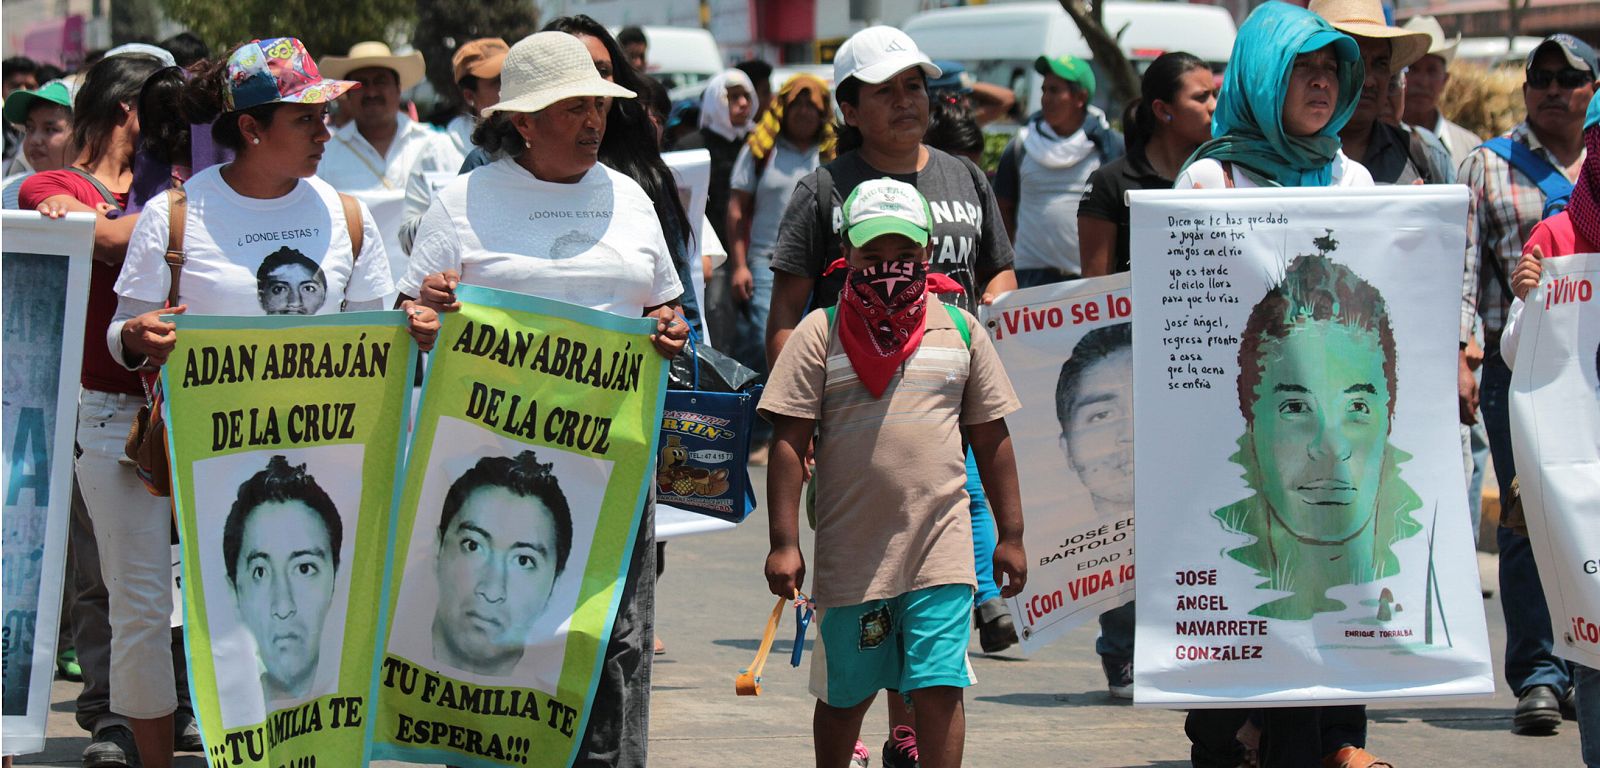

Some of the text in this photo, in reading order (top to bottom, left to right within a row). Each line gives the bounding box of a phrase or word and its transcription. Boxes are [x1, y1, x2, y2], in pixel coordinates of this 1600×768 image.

[1193, 219, 1205, 231] que
[1226, 212, 1243, 225] has
[1248, 212, 1289, 231] quedado
[245, 232, 280, 244] DONDE
[281, 228, 312, 240] ESTAS
[1170, 228, 1245, 246] a jugar con tus
[1167, 246, 1200, 260] amigos
[1217, 246, 1227, 256] el
[1169, 264, 1229, 280] ya es tarde
[1169, 280, 1179, 290] el
[1209, 278, 1232, 289] llora
[1162, 295, 1183, 305] para
[1187, 295, 1202, 309] que
[996, 294, 1132, 340] ¡Vivo se lo
[1163, 335, 1238, 350] regresa pronto
[182, 332, 391, 388] ADAN ABRAJÁN
[452, 320, 644, 392] ADAN ABRAJÁN
[1170, 353, 1203, 361] a casa
[1167, 365, 1183, 380] que
[1187, 363, 1199, 375] la
[1168, 380, 1180, 390] se
[211, 402, 356, 452] DE LA CRUZ
[465, 381, 612, 455] DE LA CRUZ
[1059, 525, 1109, 548] JOSÉ
[1039, 532, 1127, 566] BARTOLO
[1077, 547, 1135, 571] EDAD 1
[1175, 569, 1217, 586] JOSÉ
[1025, 564, 1136, 626] ¡Con VIDA lo
[1176, 594, 1229, 611] ÁNGEL
[1176, 620, 1268, 636] NAVARRETE
[1344, 629, 1414, 638] ENRIQUE TORRALBA
[1571, 616, 1600, 644] ¡Co
[1175, 645, 1264, 661] GONZÁLEZ
[420, 672, 541, 721] FAMILIA
[547, 698, 578, 738] TE
[266, 701, 323, 750] AMILIA
[328, 696, 363, 728] TE
[395, 713, 531, 765] ESPERA!!!
